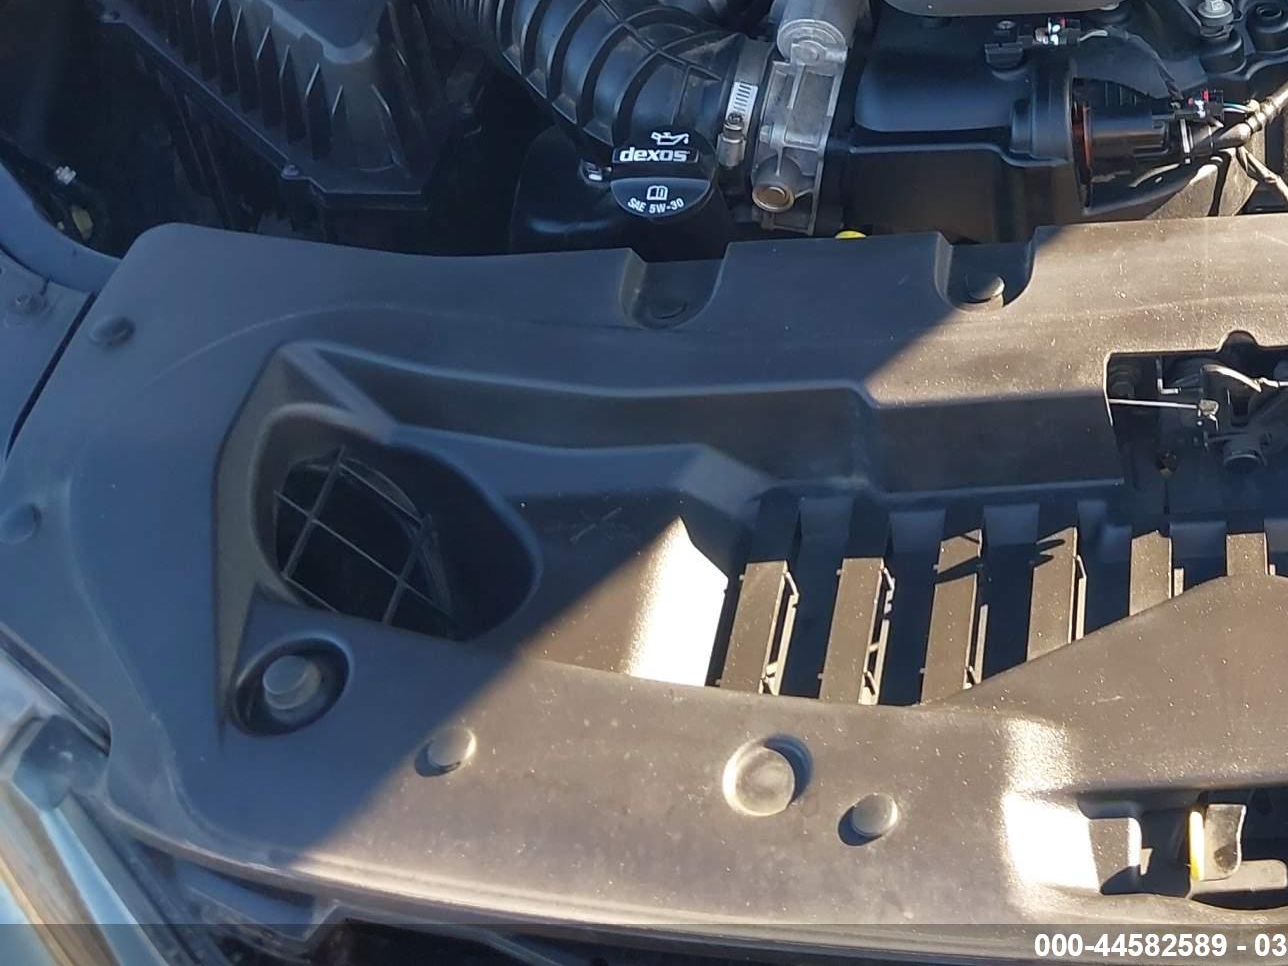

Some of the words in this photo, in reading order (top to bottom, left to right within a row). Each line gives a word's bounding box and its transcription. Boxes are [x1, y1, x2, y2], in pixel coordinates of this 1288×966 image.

[619, 146, 690, 163] dexos
[627, 197, 646, 212] SAE
[649, 198, 684, 213] 5W-30
